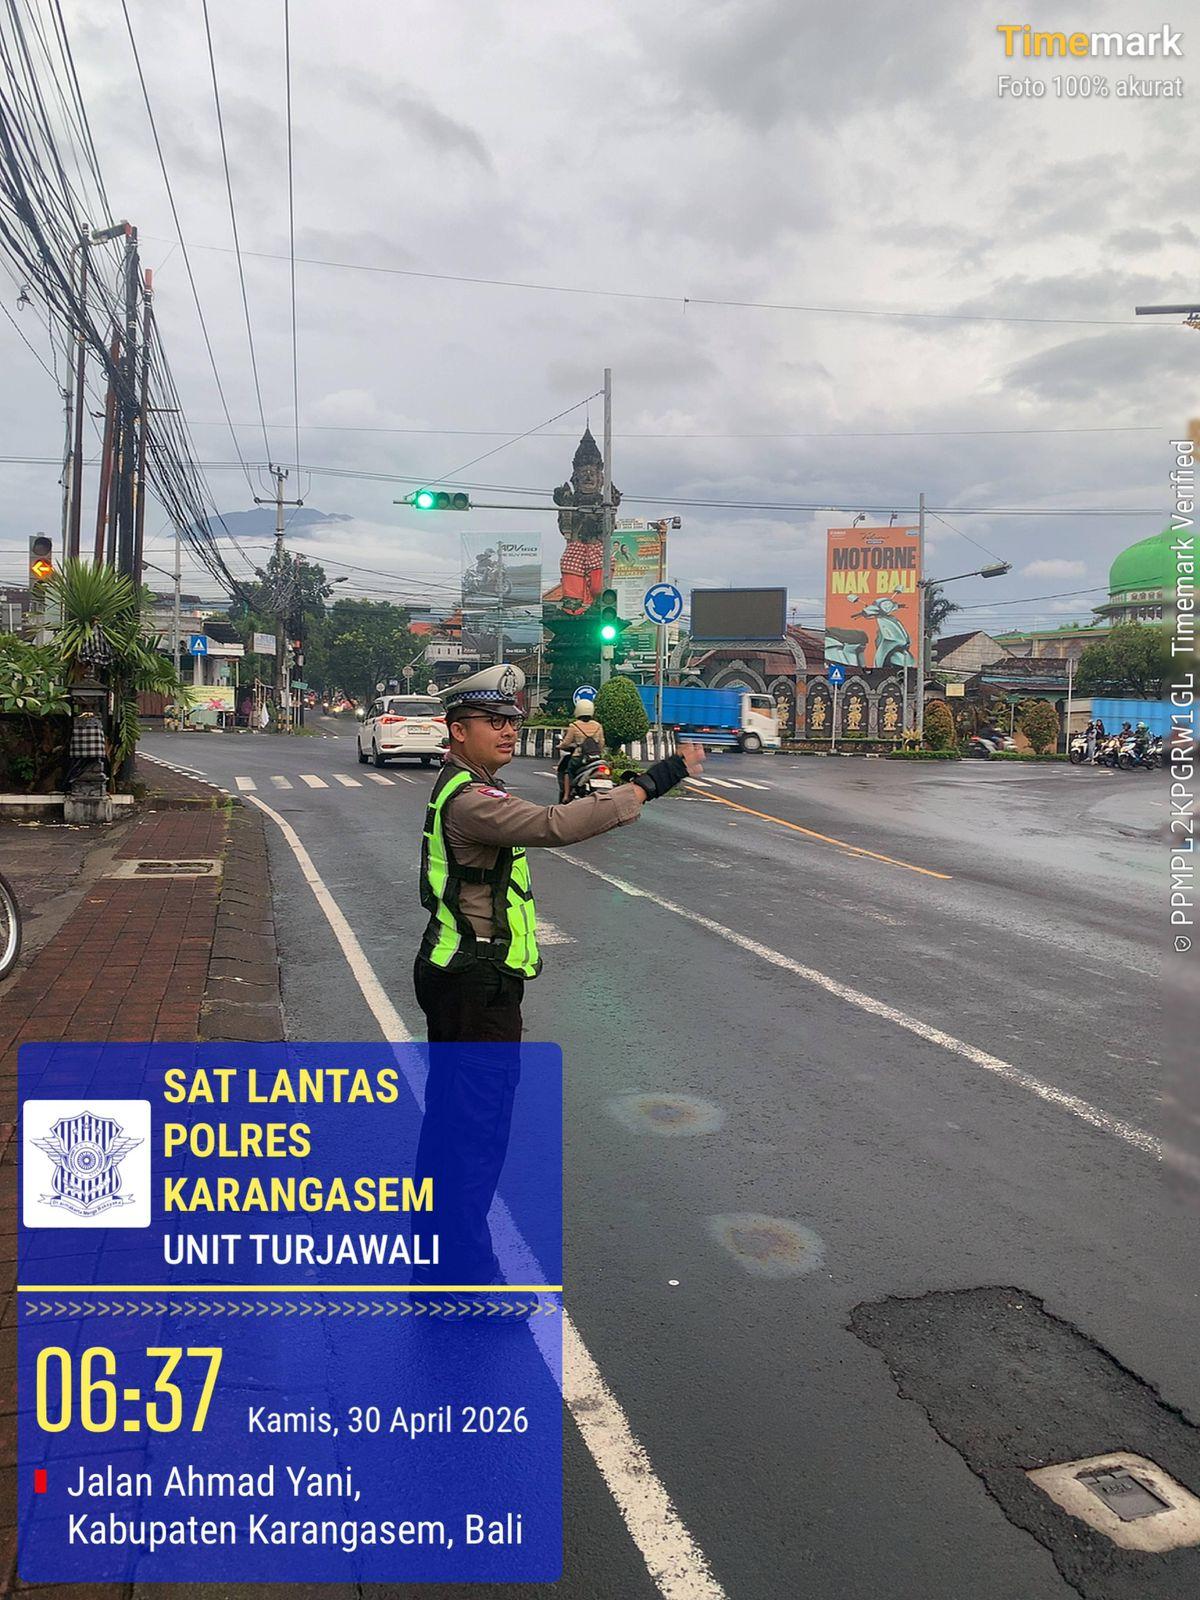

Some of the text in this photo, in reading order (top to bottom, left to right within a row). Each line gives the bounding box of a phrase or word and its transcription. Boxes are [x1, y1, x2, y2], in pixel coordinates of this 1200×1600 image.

[832, 546, 917, 570] MOTORNE
[831, 570, 916, 594] NAK BALI
